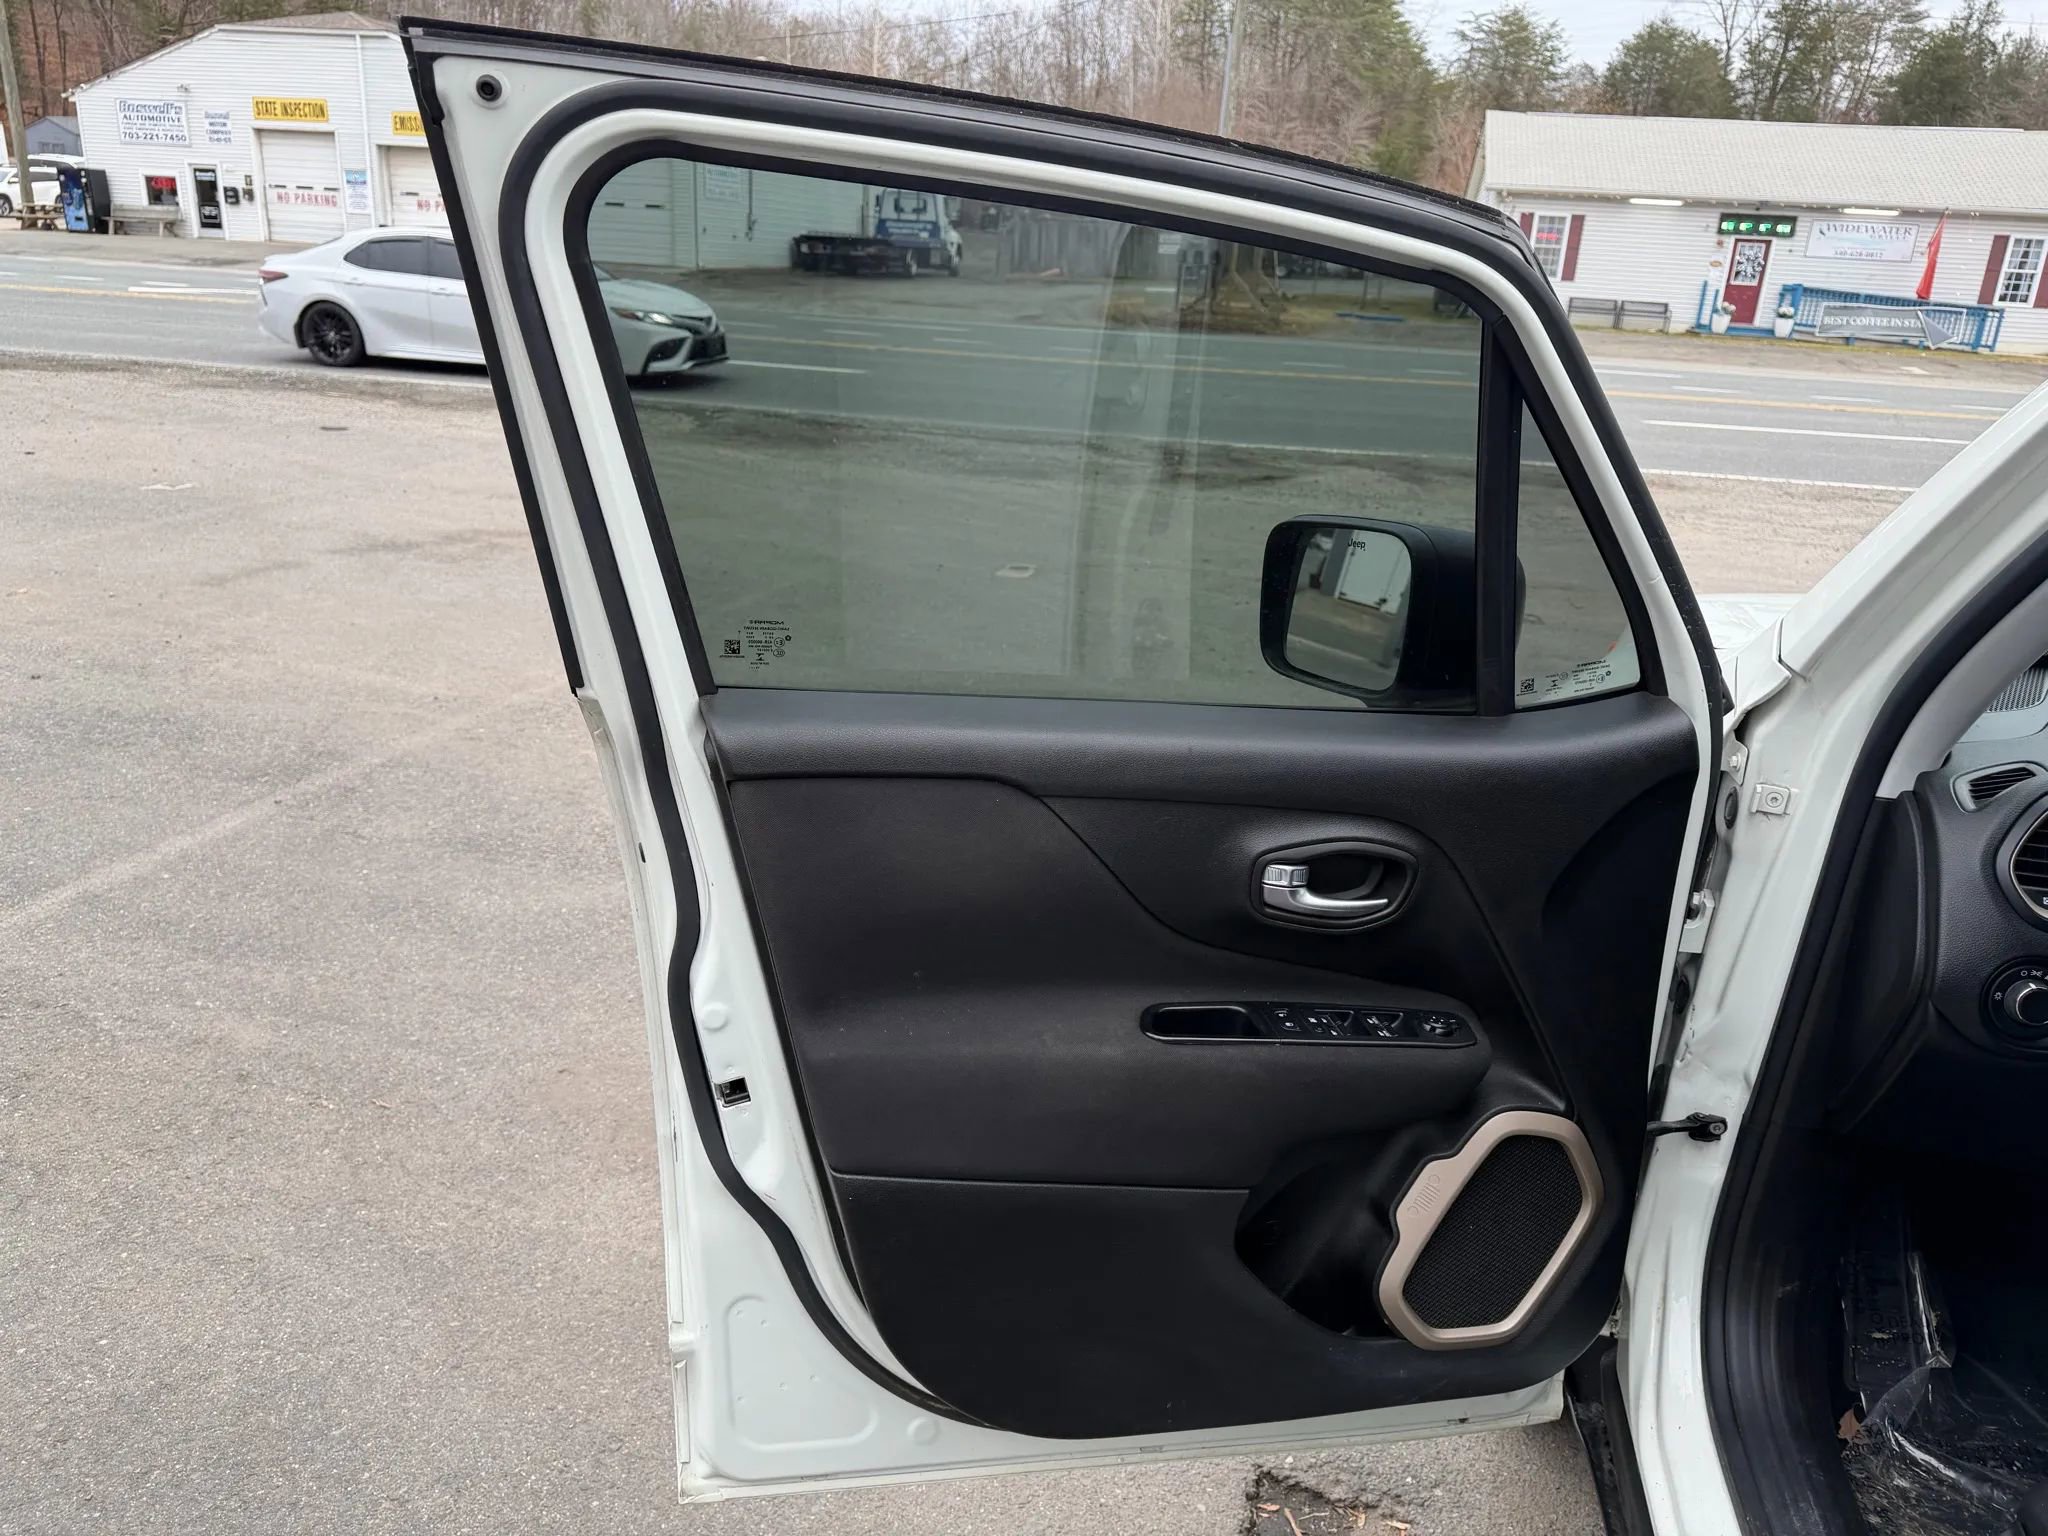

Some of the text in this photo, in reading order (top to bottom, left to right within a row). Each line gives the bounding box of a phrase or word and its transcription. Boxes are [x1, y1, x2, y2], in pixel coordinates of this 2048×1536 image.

[255, 100, 326, 119] STATE INSPECTION
[122, 113, 182, 124] AUTOMOTIVE
[122, 131, 187, 142] 703-221-7450
[277, 191, 290, 204] NO
[294, 192, 337, 208] PARKING
[416, 199, 431, 211] NO
[1826, 222, 1913, 237] WIDEWATER
[1823, 315, 1851, 326] BEST
[1851, 316, 1890, 327] COFFEE
[1904, 318, 1924, 329] STA
[1347, 538, 1366, 550] Jeep
